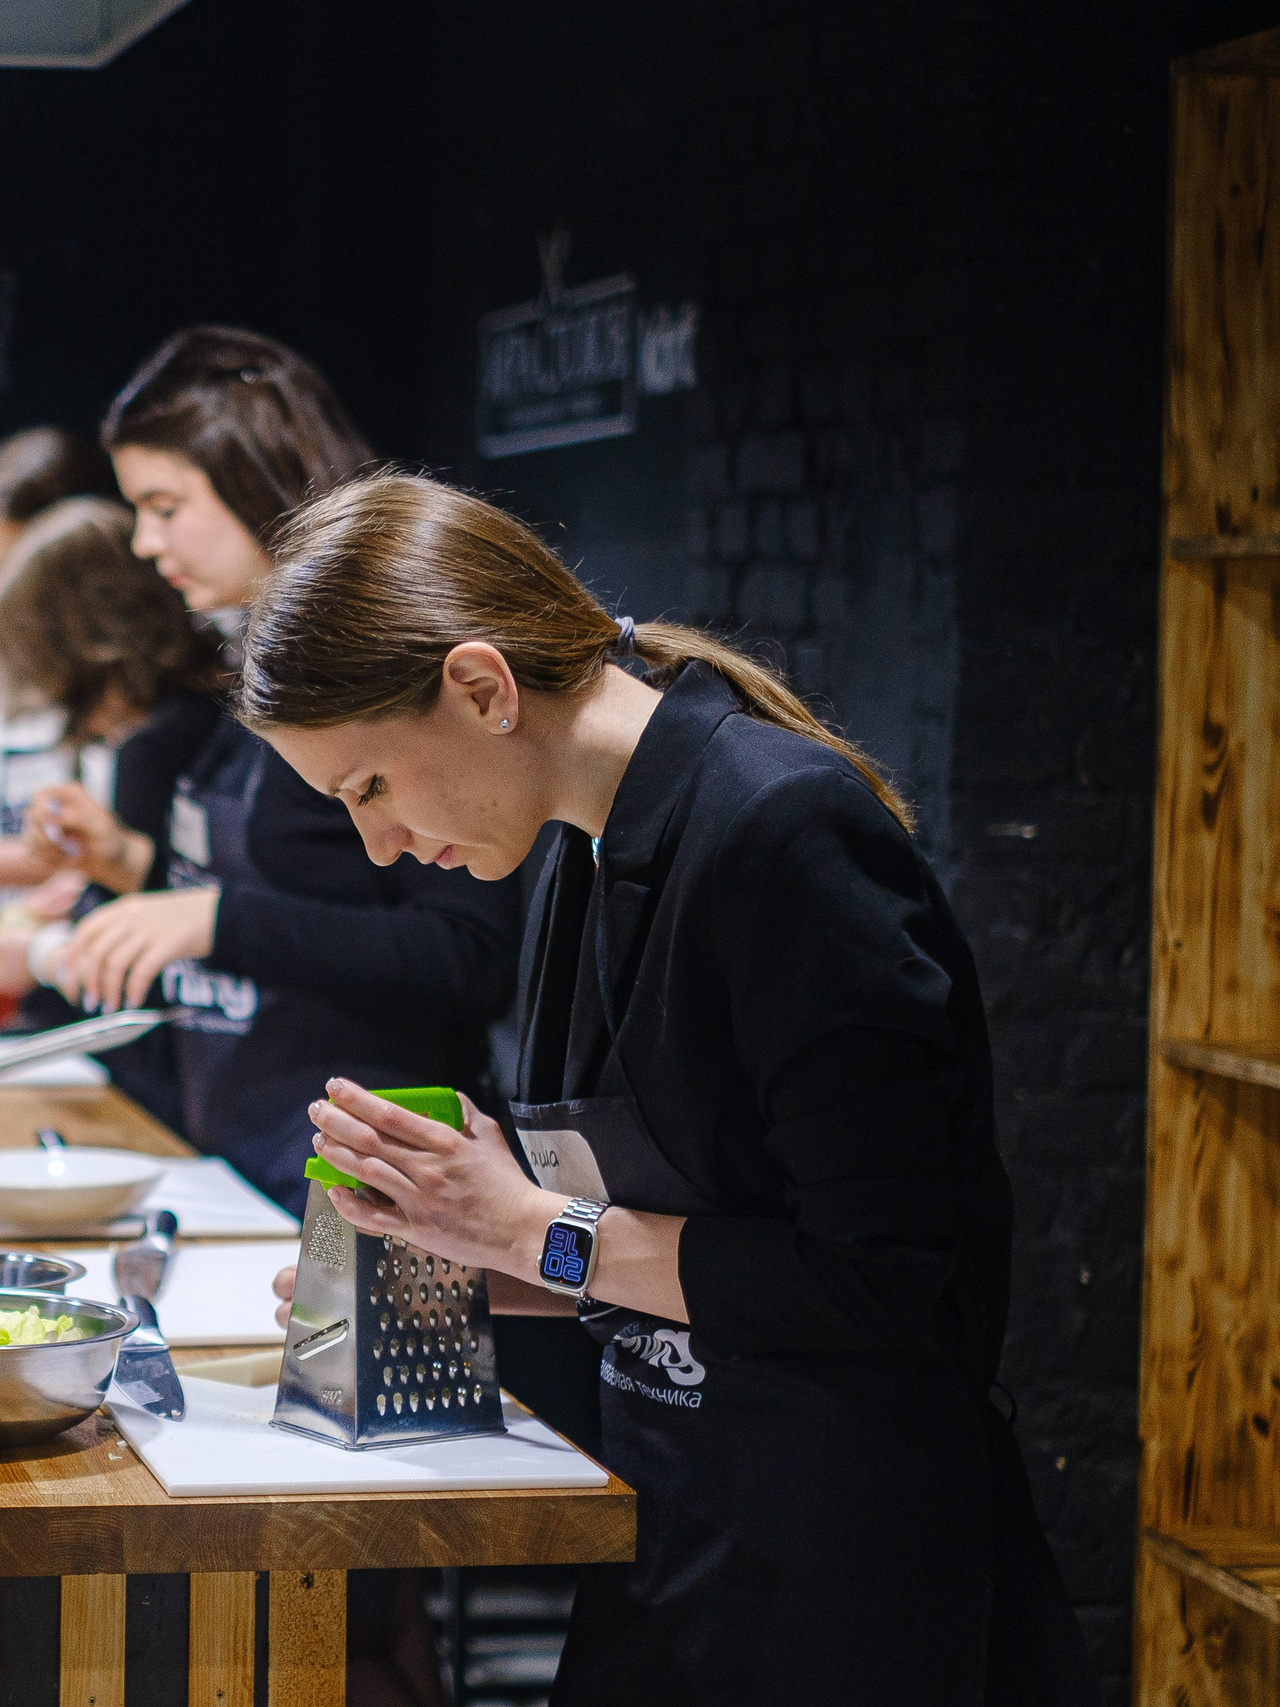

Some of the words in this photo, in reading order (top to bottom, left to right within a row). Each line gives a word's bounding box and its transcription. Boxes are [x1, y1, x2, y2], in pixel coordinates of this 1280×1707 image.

[528, 1149, 559, 1169] аша
[548, 1227, 578, 1257] 16
[543, 1250, 584, 1283] 20
